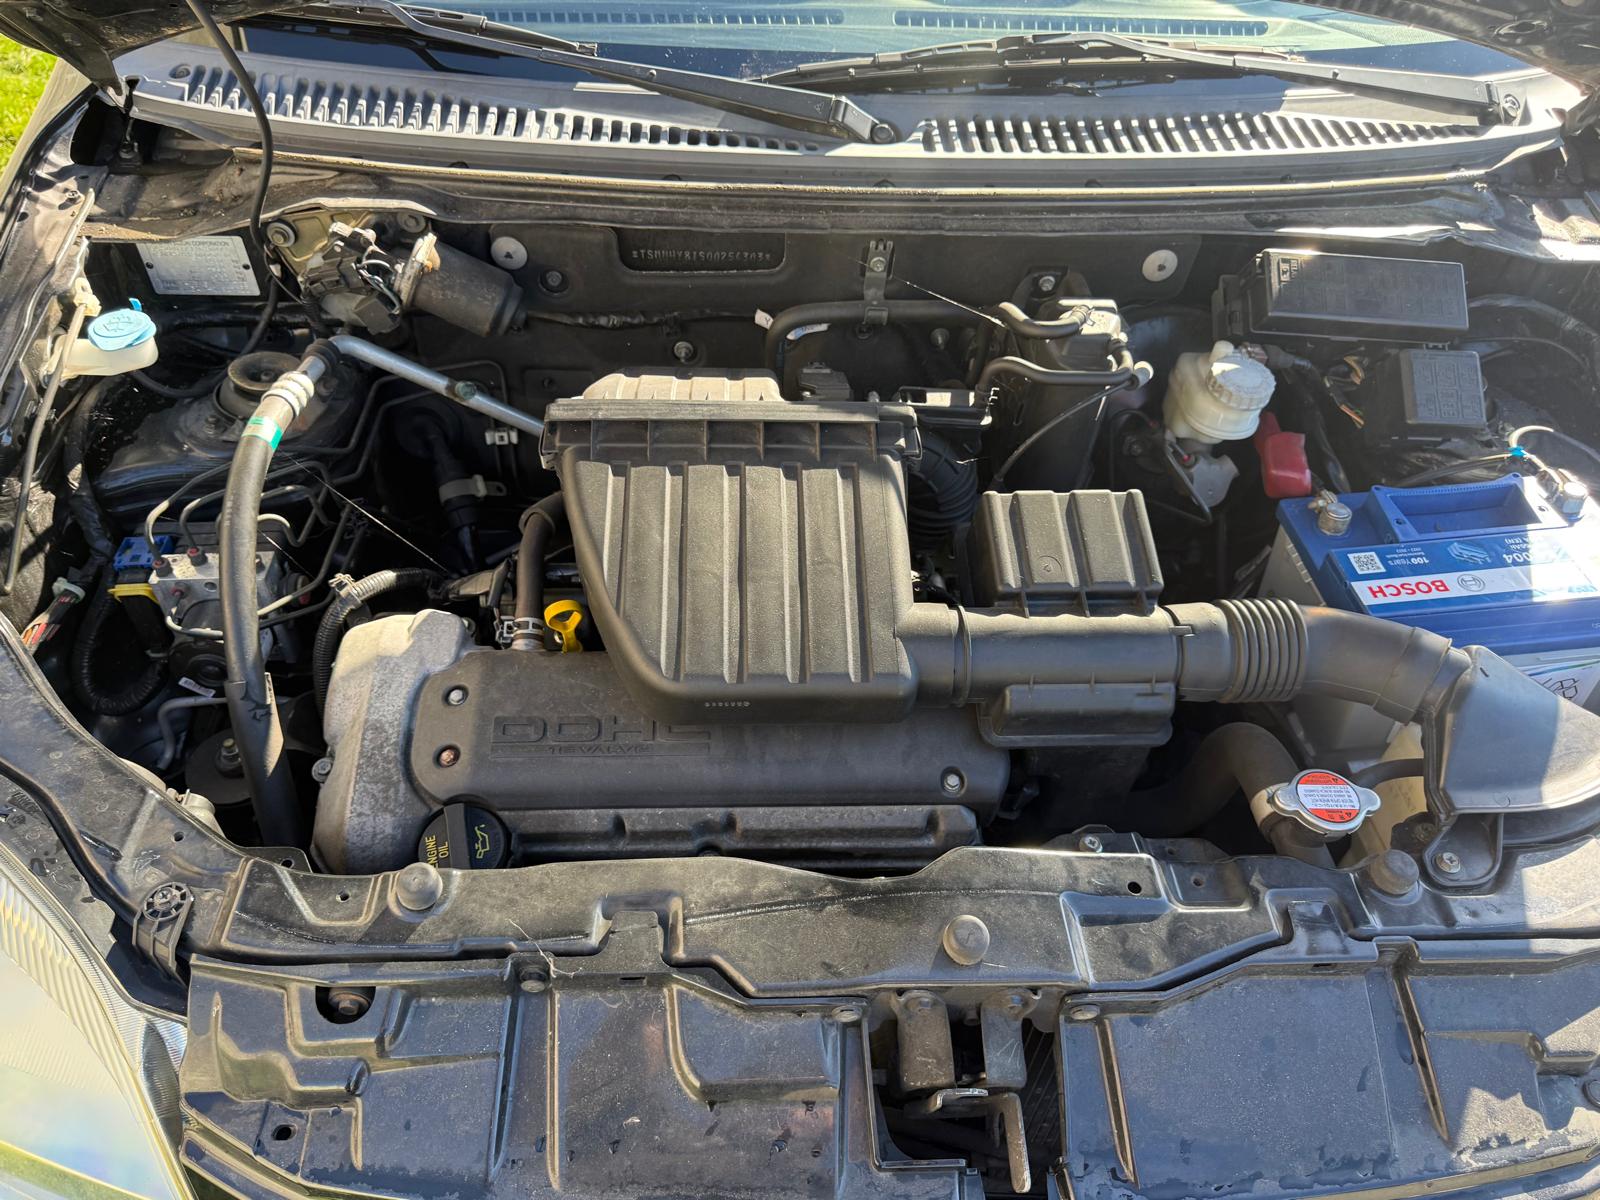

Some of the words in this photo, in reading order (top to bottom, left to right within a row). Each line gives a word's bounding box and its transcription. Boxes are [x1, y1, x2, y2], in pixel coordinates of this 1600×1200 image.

[1410, 556, 1430, 565] 100
[1367, 579, 1450, 598] BOSCH
[491, 715, 711, 743] DOHC
[438, 841, 449, 859] OIL
